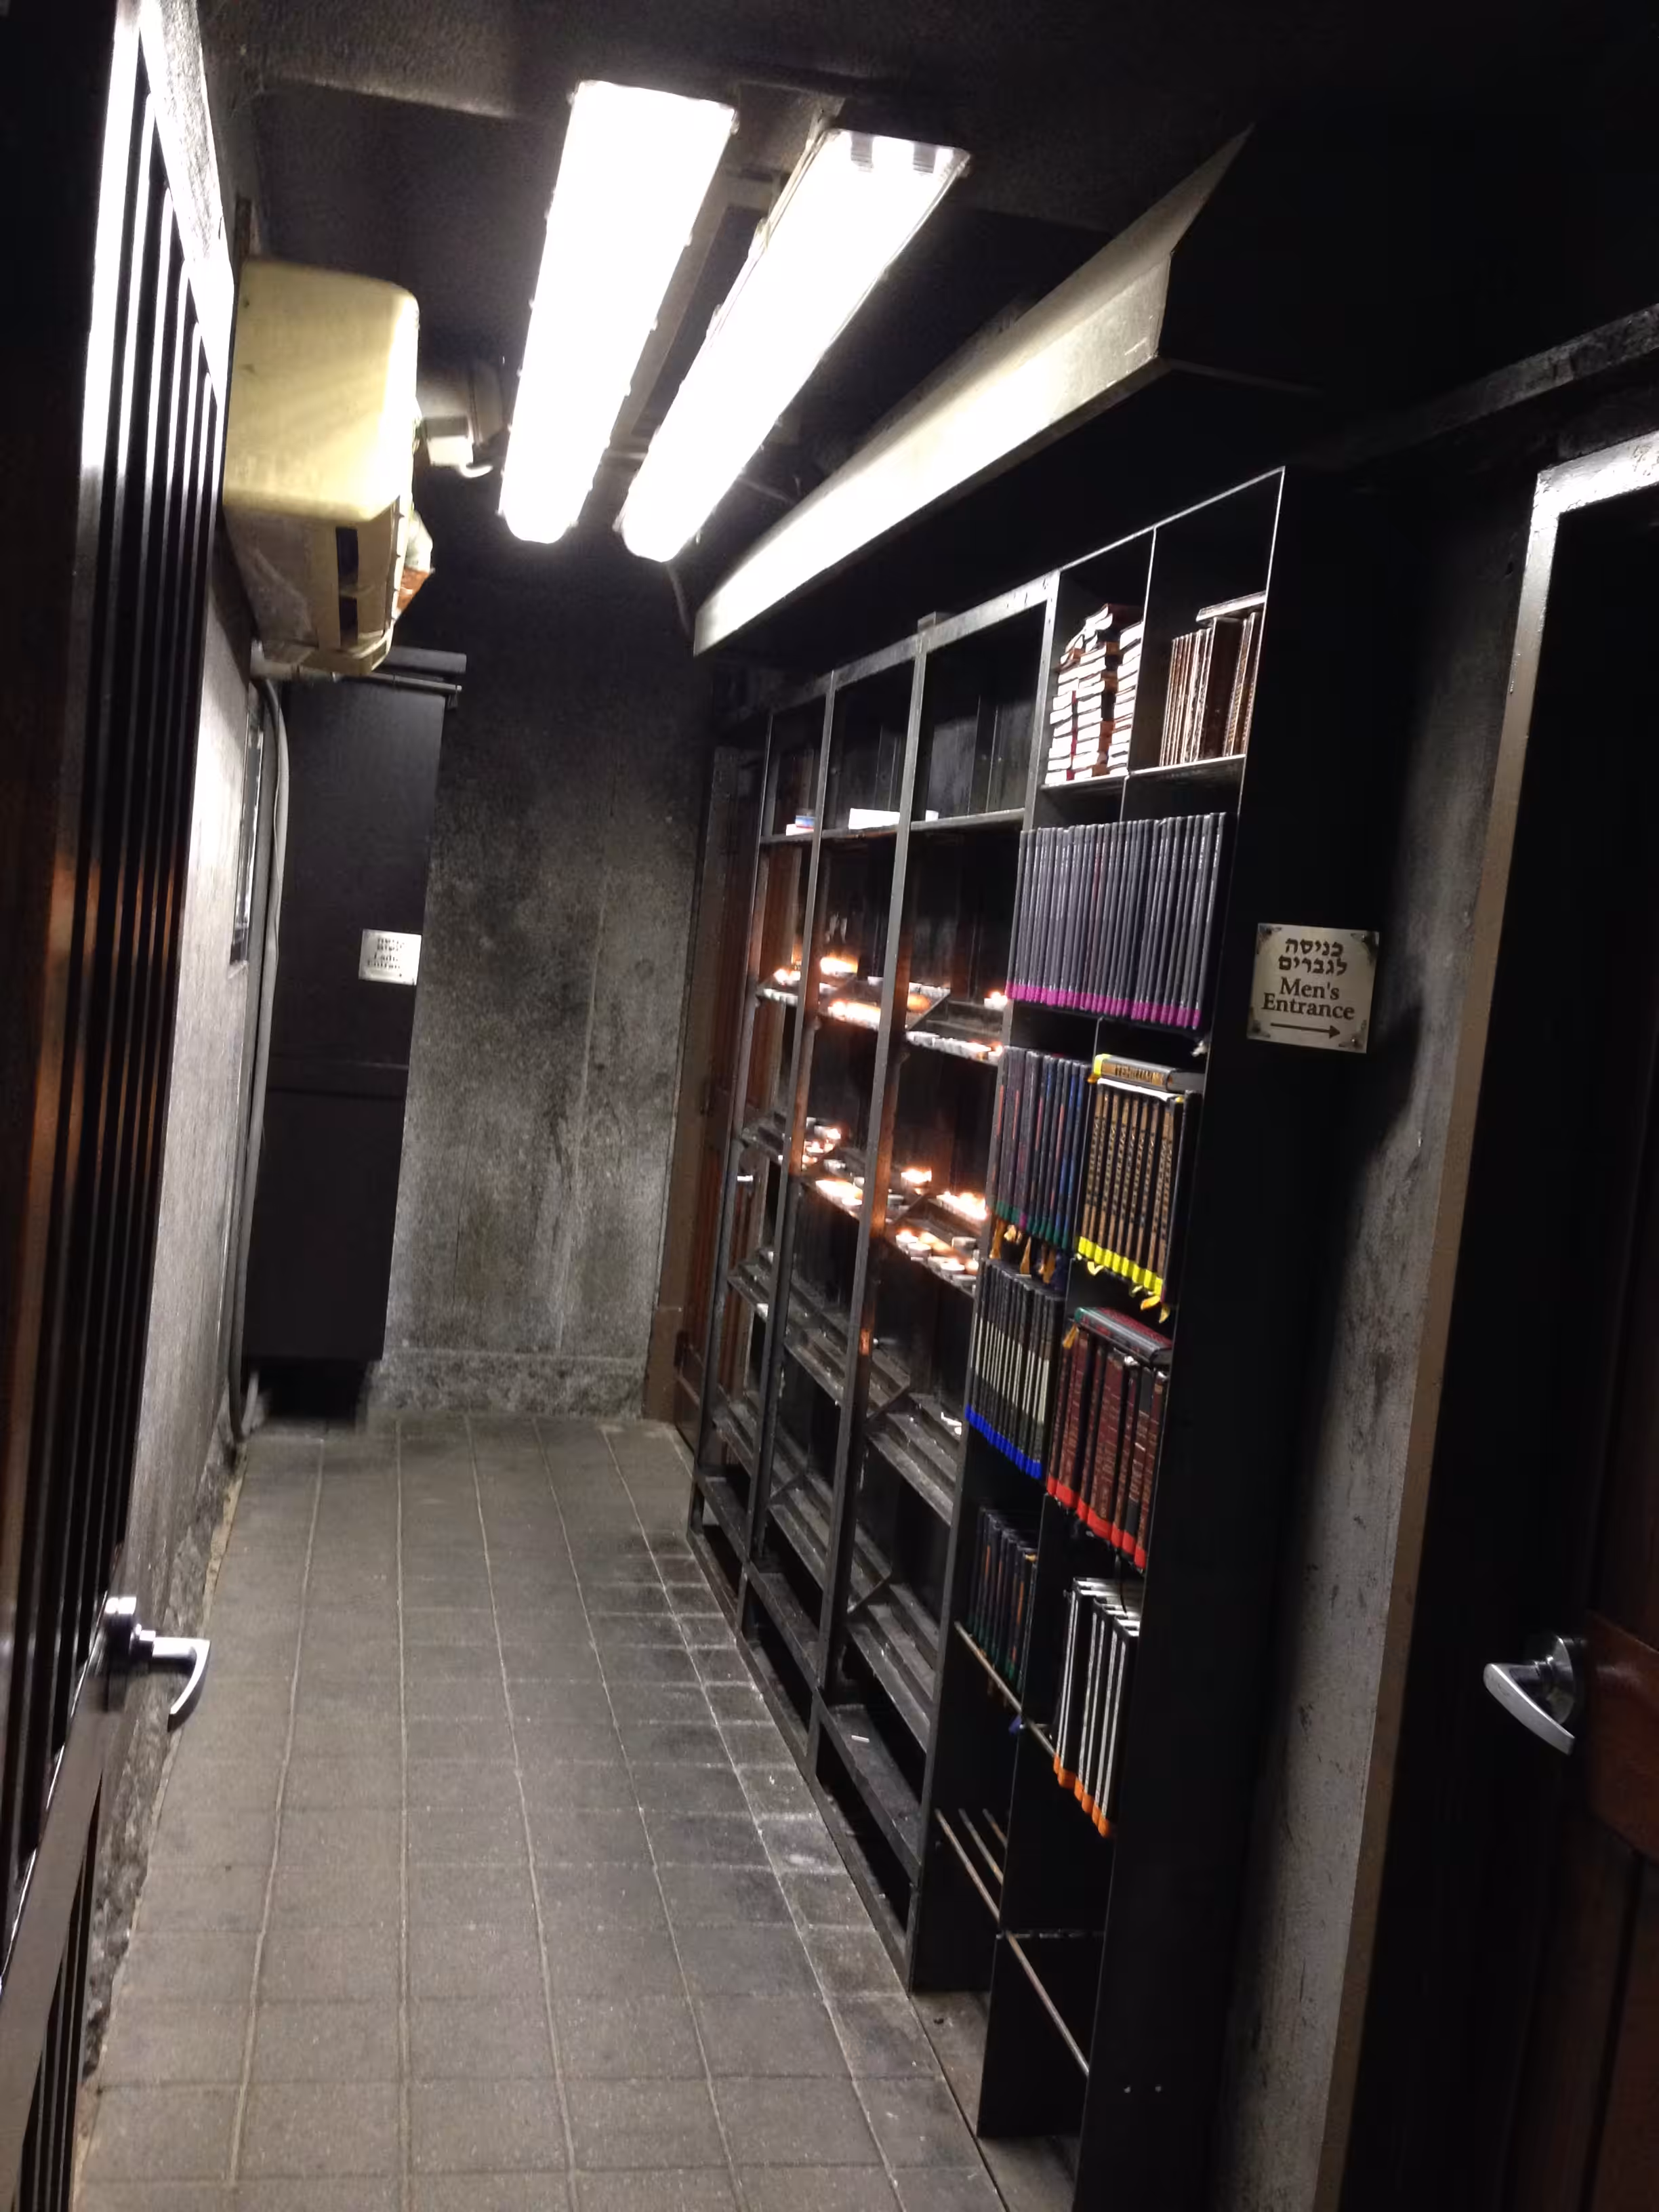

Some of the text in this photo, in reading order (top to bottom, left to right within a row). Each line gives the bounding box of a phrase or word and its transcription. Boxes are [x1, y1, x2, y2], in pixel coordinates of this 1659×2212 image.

[1285, 938, 1344, 958] כניסה
[1278, 955, 1348, 976] לגברים
[1280, 977, 1340, 1000] Men's
[1261, 992, 1355, 1021] Entrance
